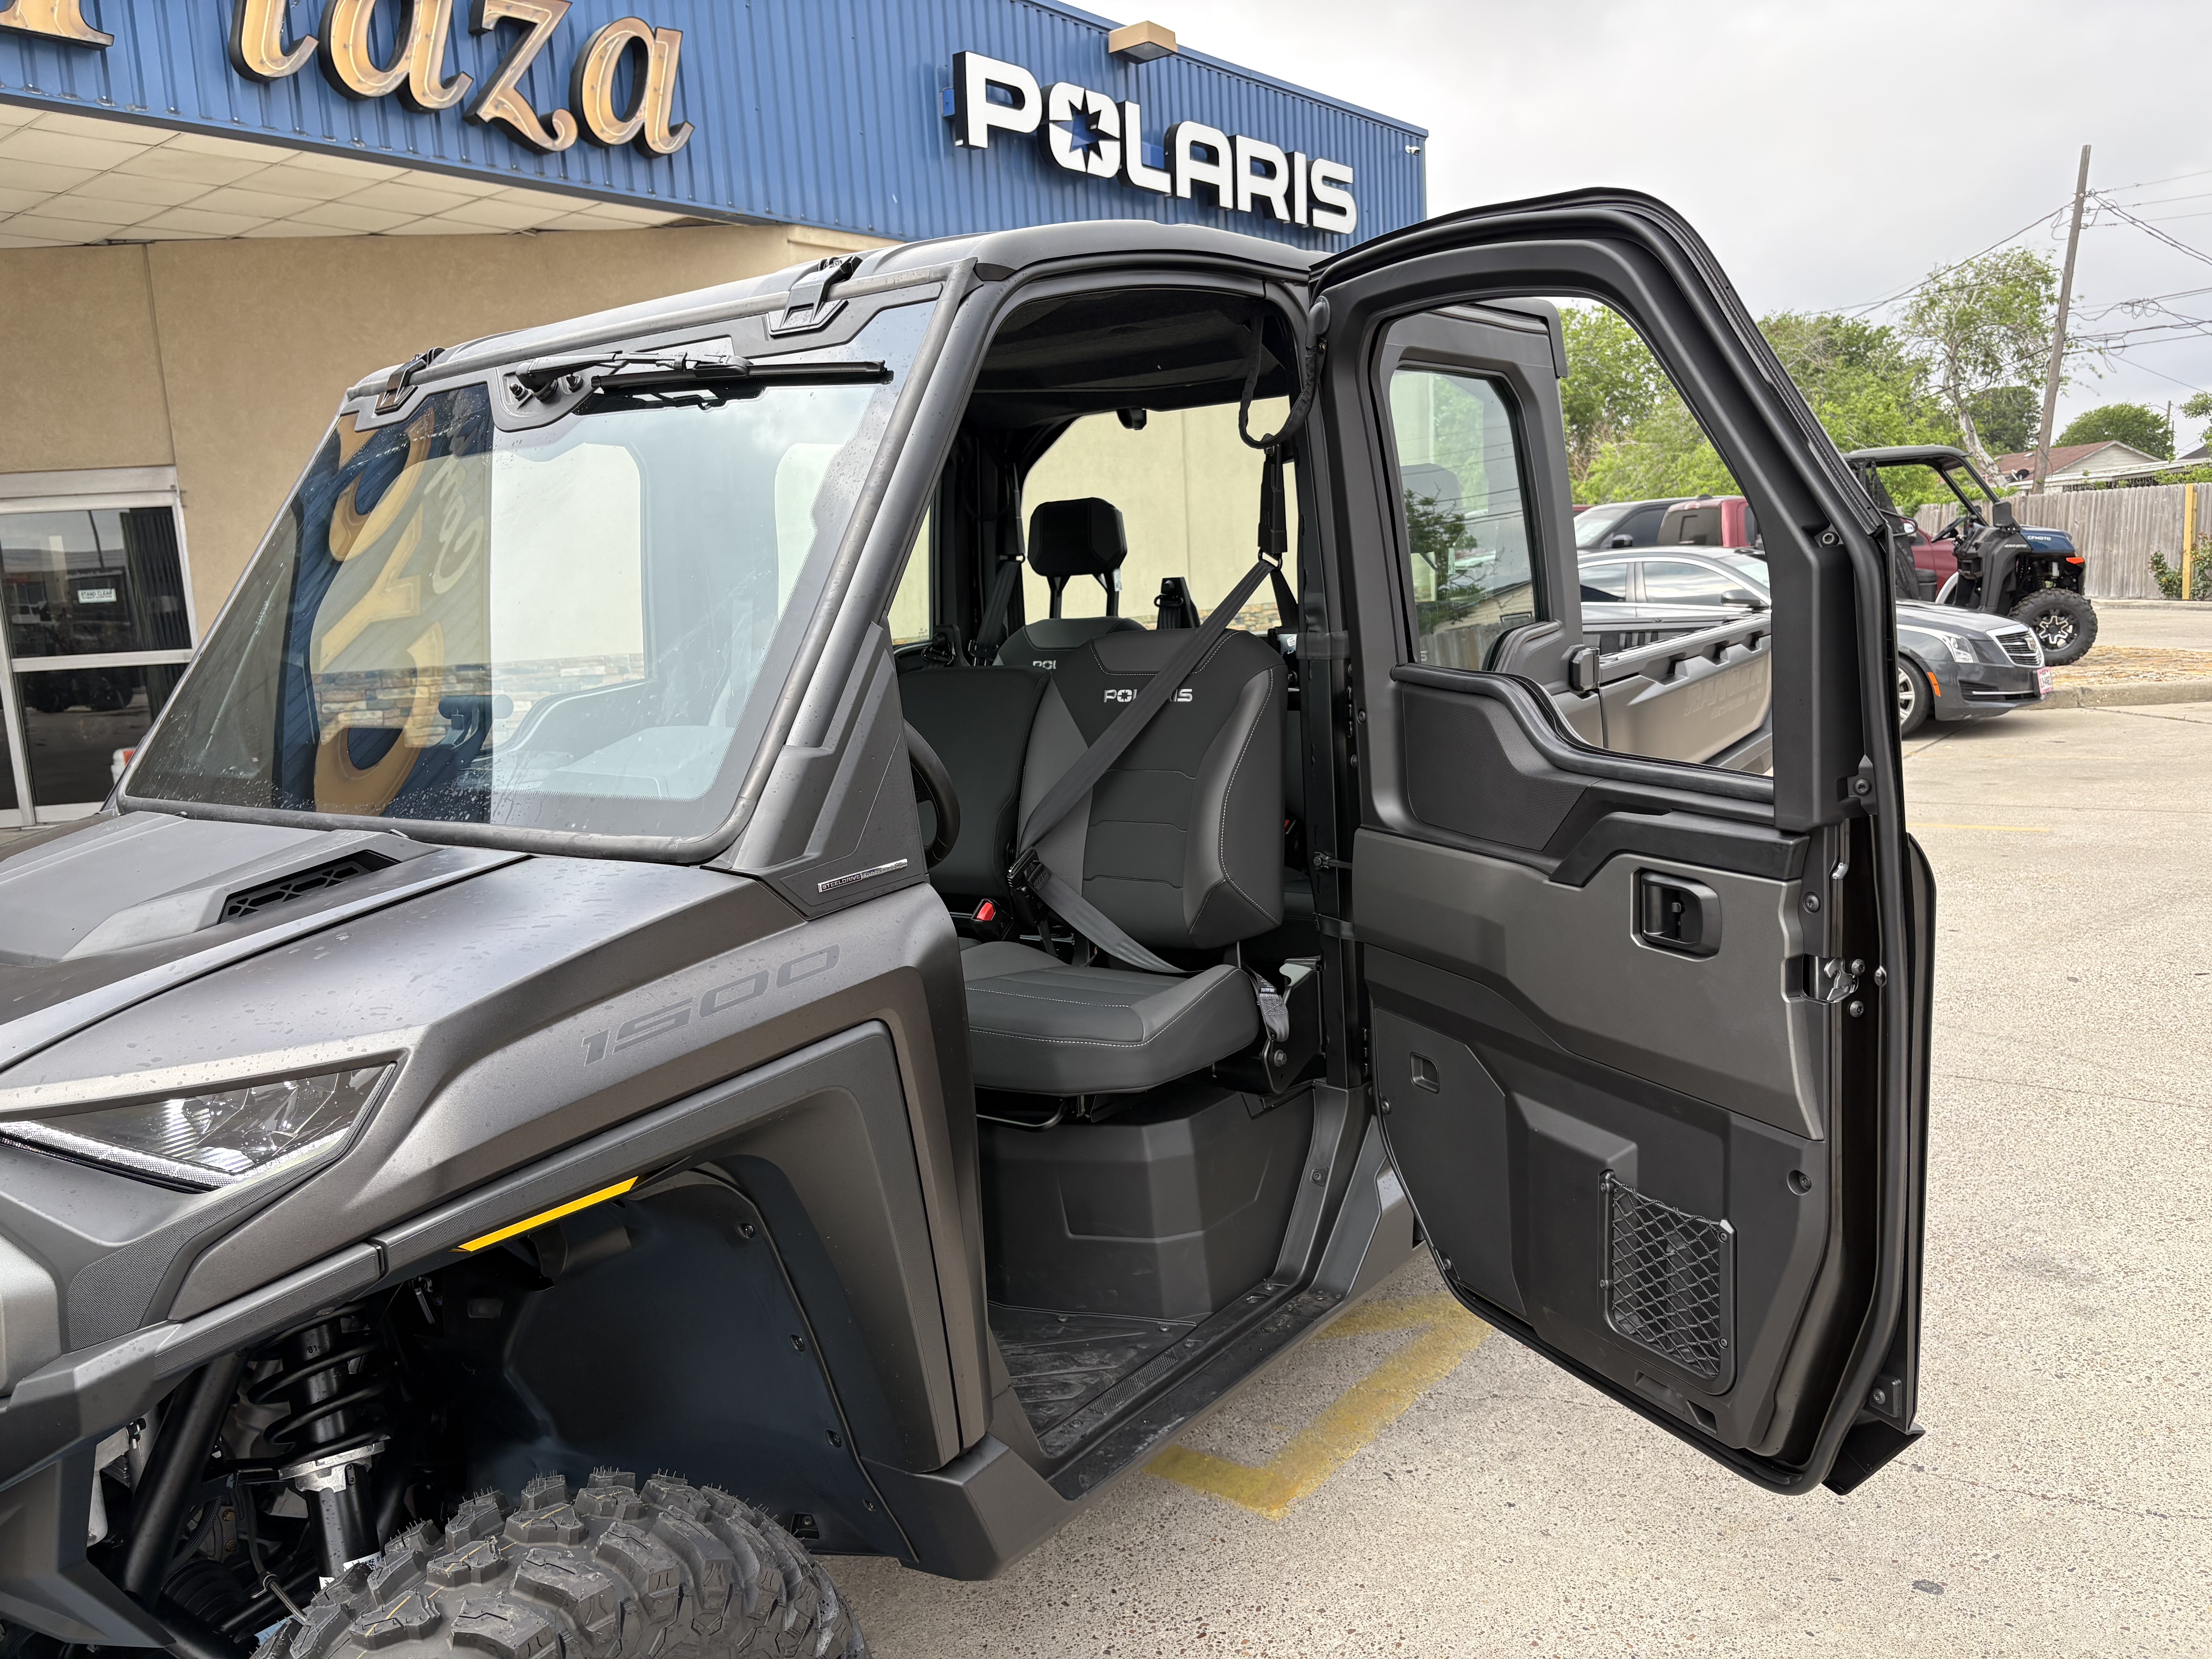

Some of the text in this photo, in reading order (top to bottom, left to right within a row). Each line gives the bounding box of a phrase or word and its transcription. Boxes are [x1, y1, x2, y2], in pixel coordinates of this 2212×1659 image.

[953, 51, 1357, 234] POLARIS
[821, 861, 908, 890] STEELDRIVE TRANSMISSION
[581, 943, 840, 1066] 1500
